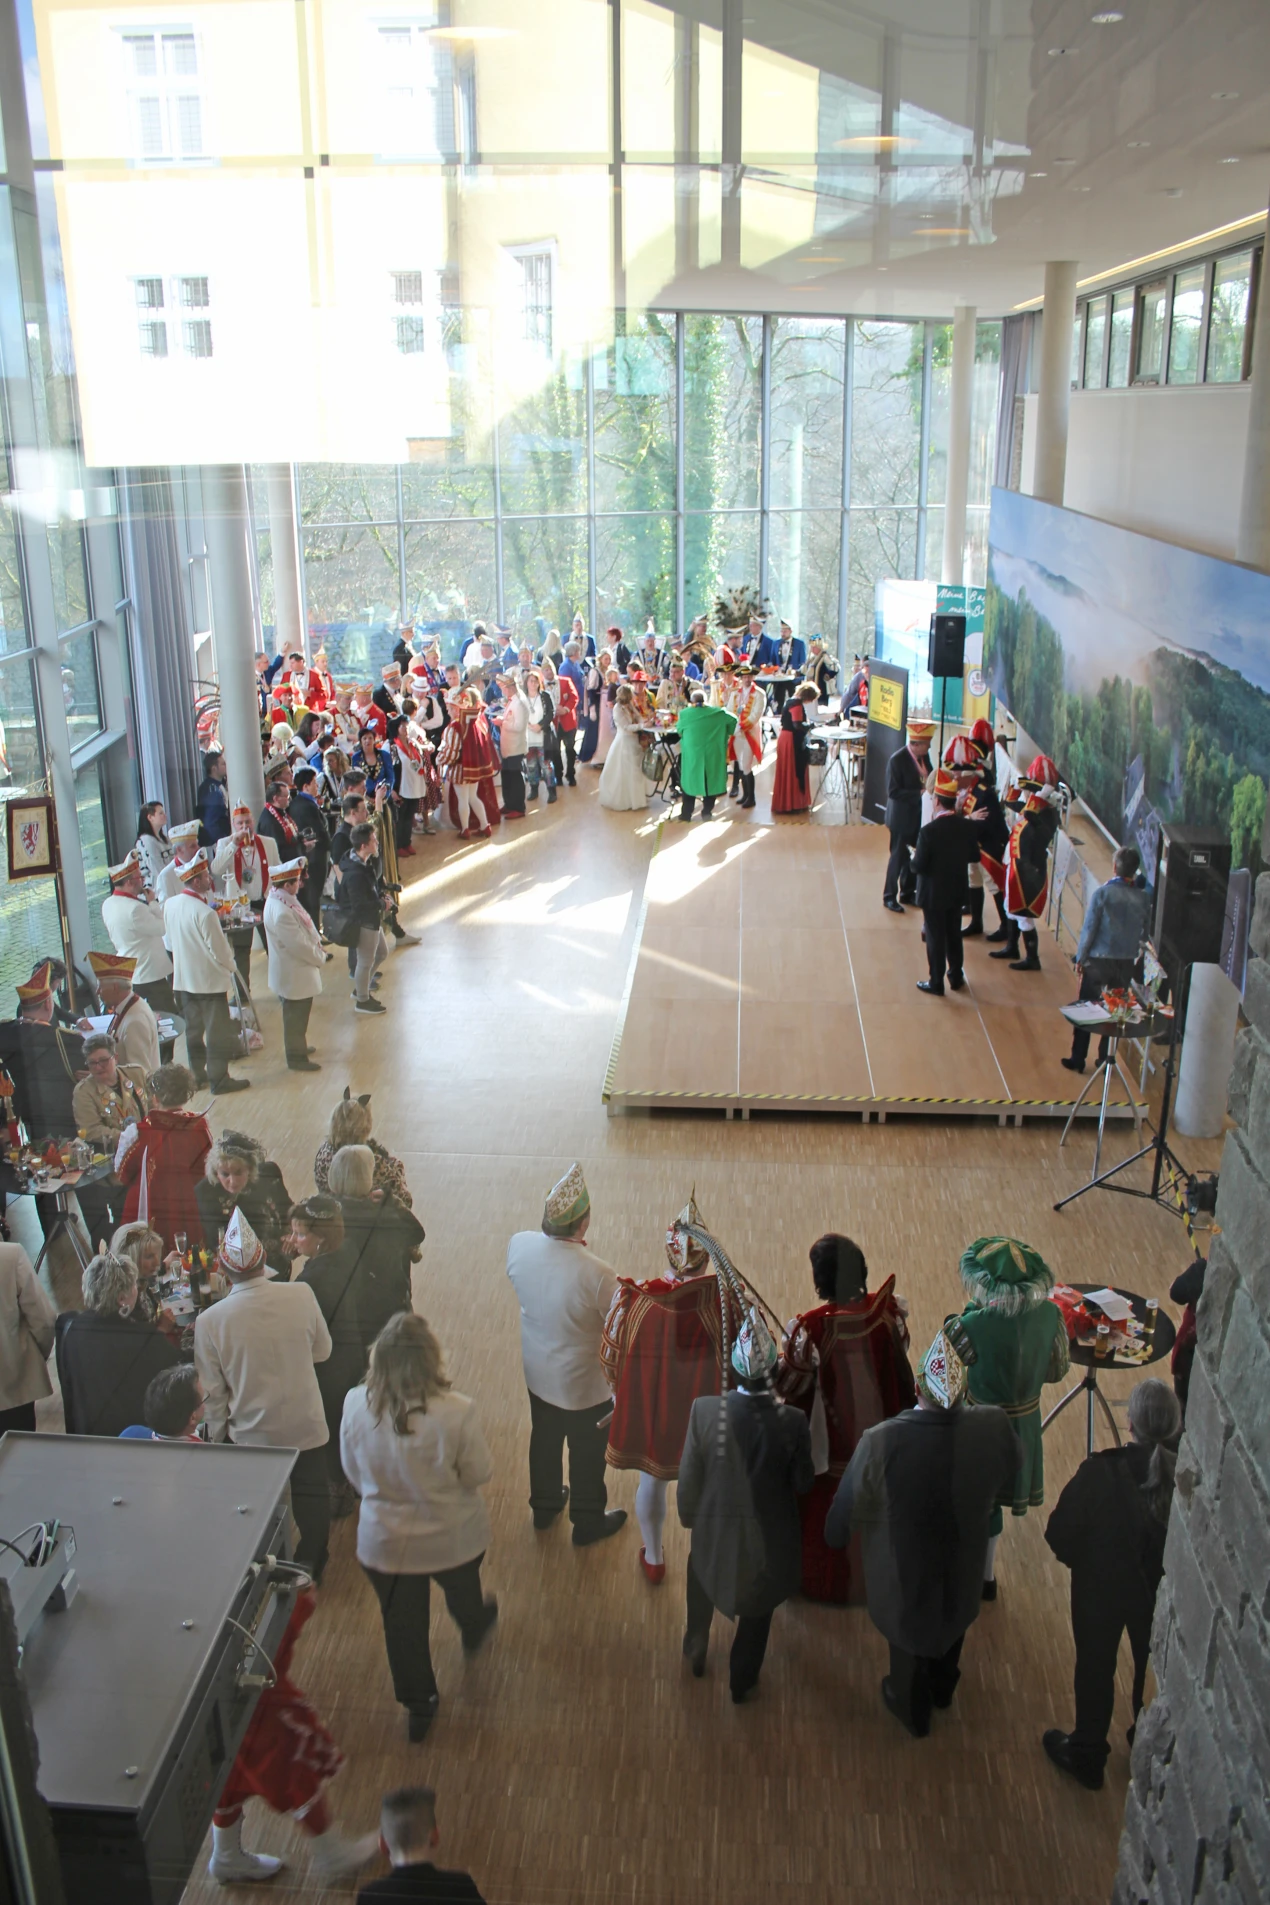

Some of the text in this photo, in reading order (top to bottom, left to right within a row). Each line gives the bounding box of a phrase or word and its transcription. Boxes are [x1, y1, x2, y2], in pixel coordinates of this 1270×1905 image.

[938, 587, 965, 599] Meine
[880, 684, 895, 697] Radio
[1194, 855, 1206, 863] JBL
